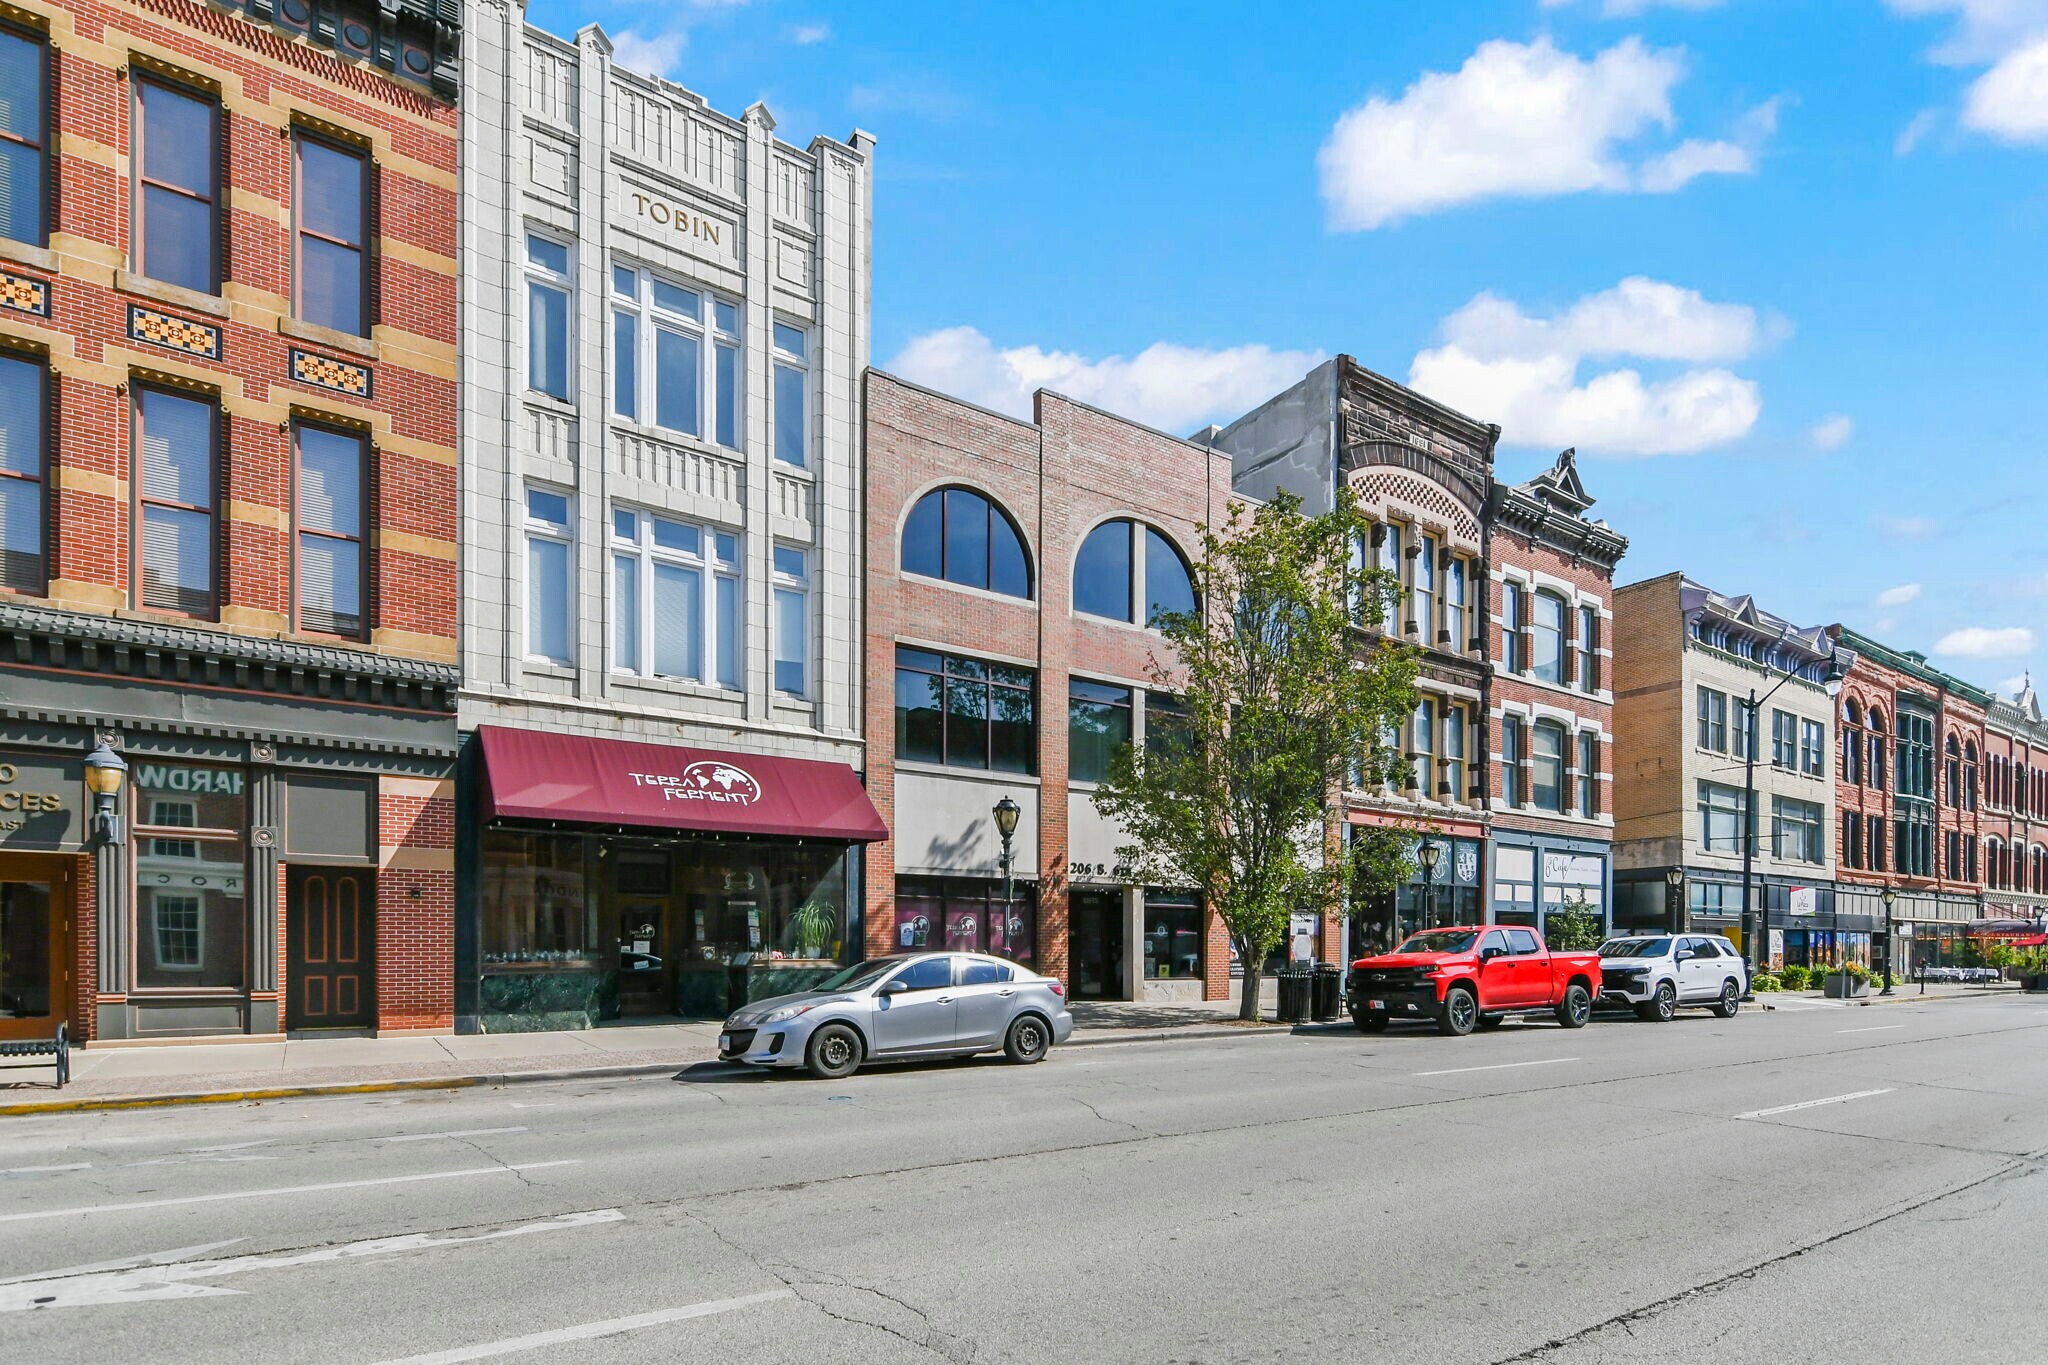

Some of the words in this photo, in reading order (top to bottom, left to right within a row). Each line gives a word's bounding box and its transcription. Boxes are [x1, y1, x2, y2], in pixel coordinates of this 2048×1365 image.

[632, 193, 720, 245] TOBIN
[628, 773, 695, 787] TERRA
[664, 788, 749, 806] FERMENT
[1070, 863, 1091, 875] 206
